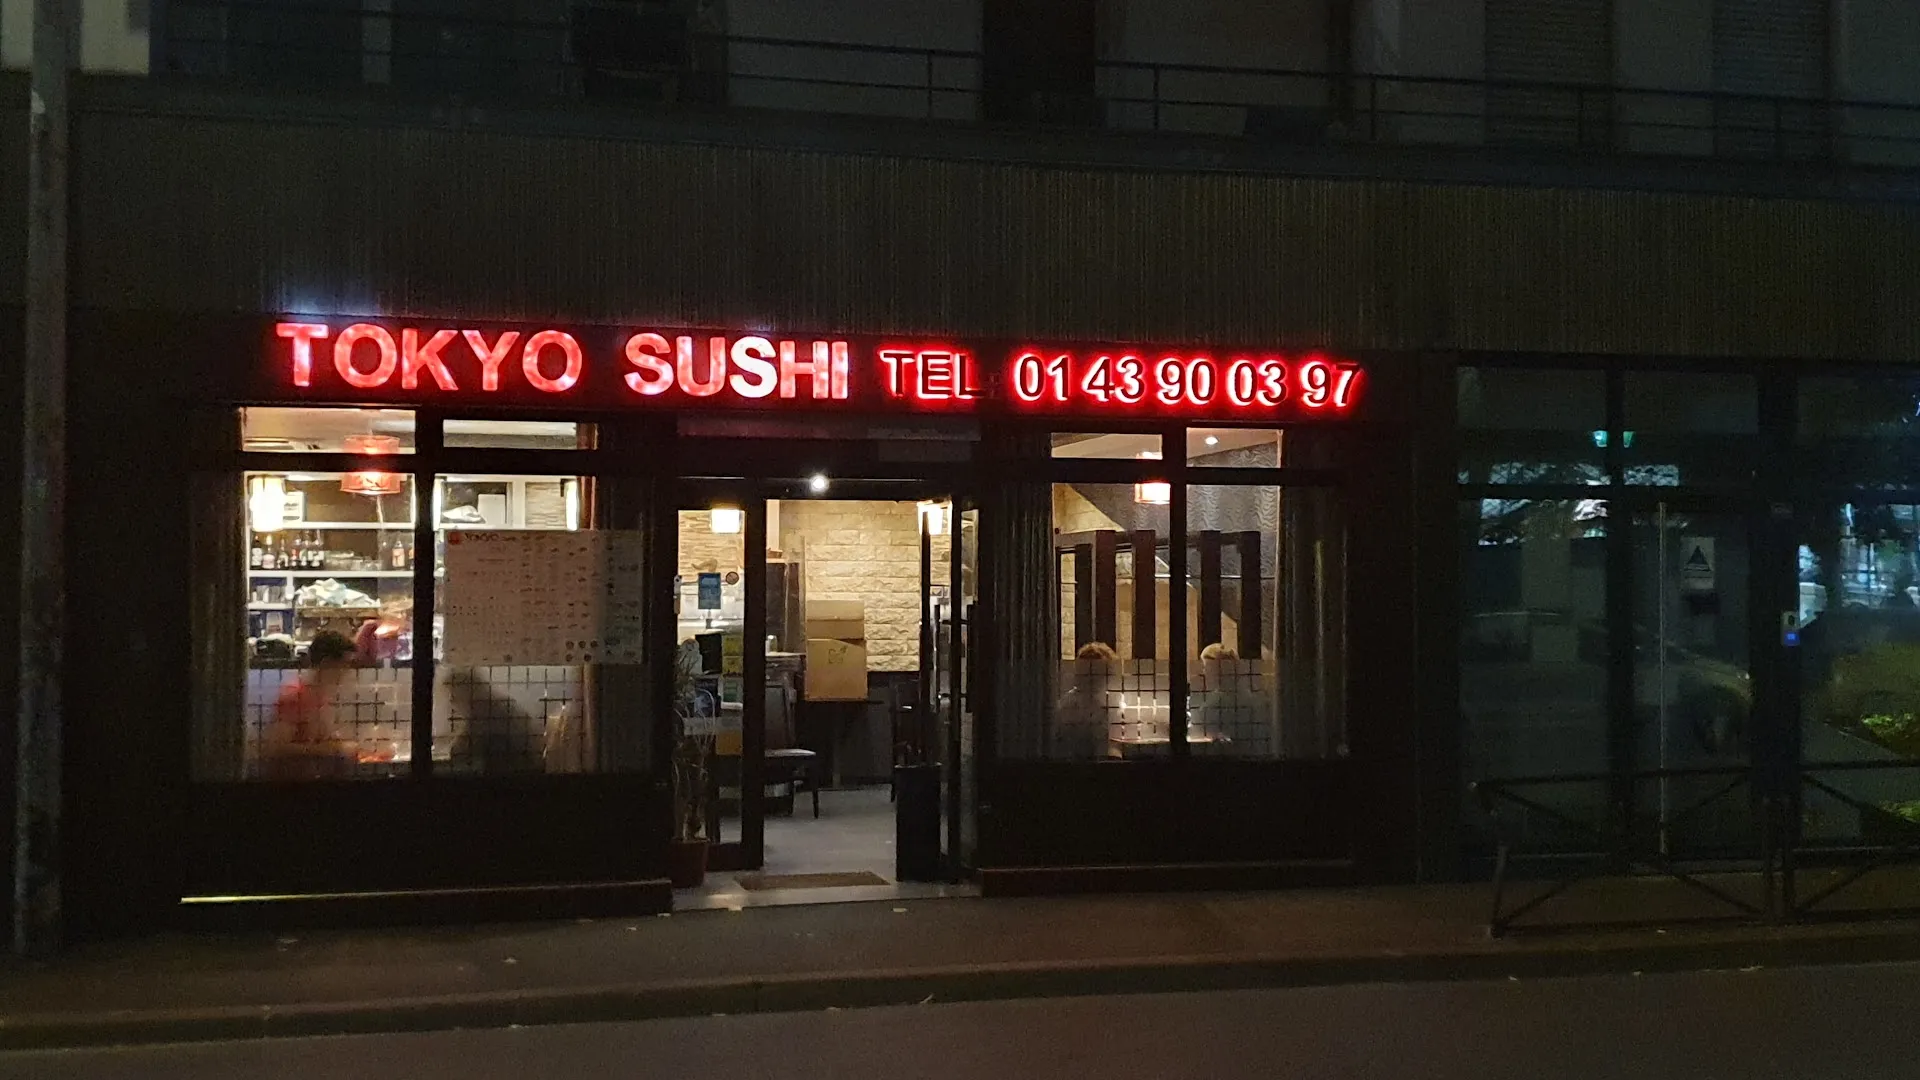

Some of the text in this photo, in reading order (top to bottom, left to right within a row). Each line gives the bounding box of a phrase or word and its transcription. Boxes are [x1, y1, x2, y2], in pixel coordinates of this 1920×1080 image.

[276, 322, 849, 401] TOKYO SUSHI
[1014, 352, 1071, 403] 01
[1082, 354, 1147, 405] 43
[1155, 356, 1217, 407] 90
[1225, 358, 1288, 408] 03
[1298, 360, 1362, 409] 97
